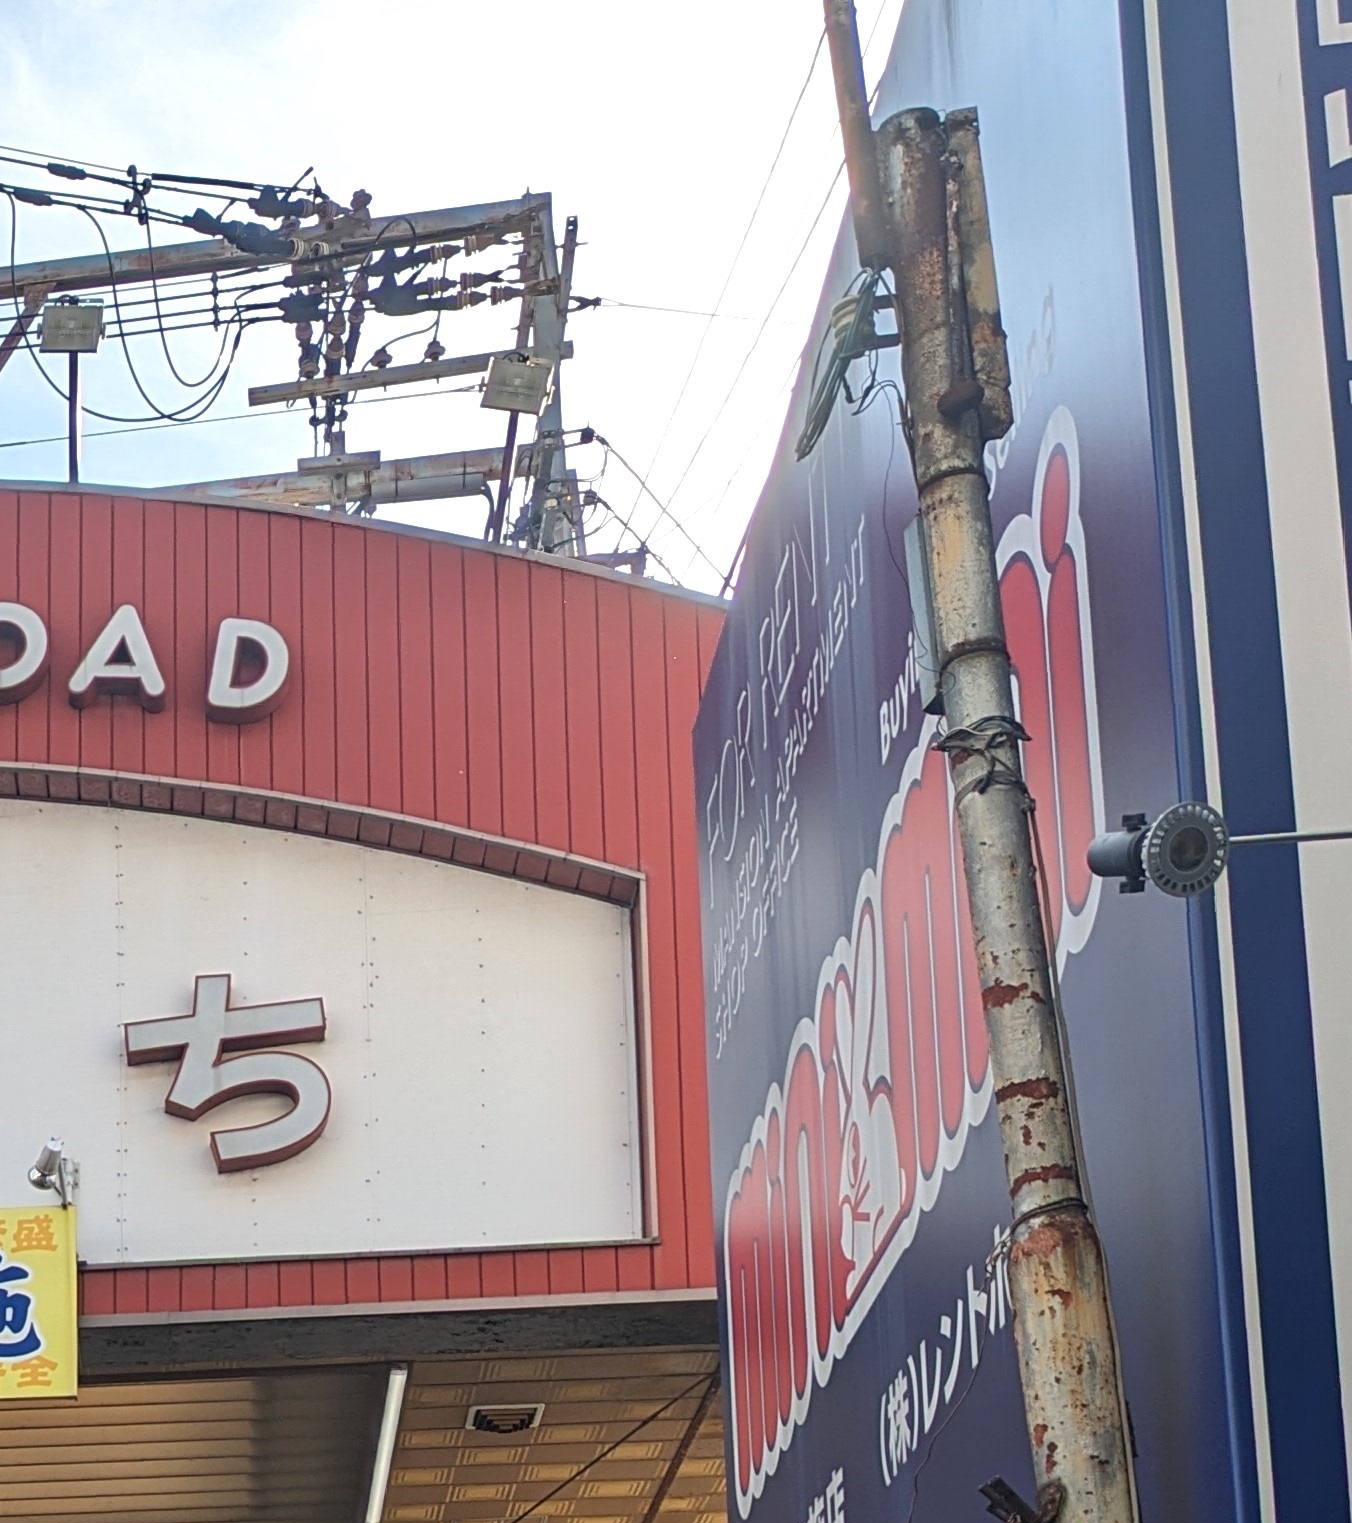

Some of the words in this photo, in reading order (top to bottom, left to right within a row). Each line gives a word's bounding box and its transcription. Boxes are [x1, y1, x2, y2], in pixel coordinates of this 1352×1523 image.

[706, 682, 756, 910] FOR
[760, 435, 830, 752] RENT
[753, 796, 799, 957] OFFICE
